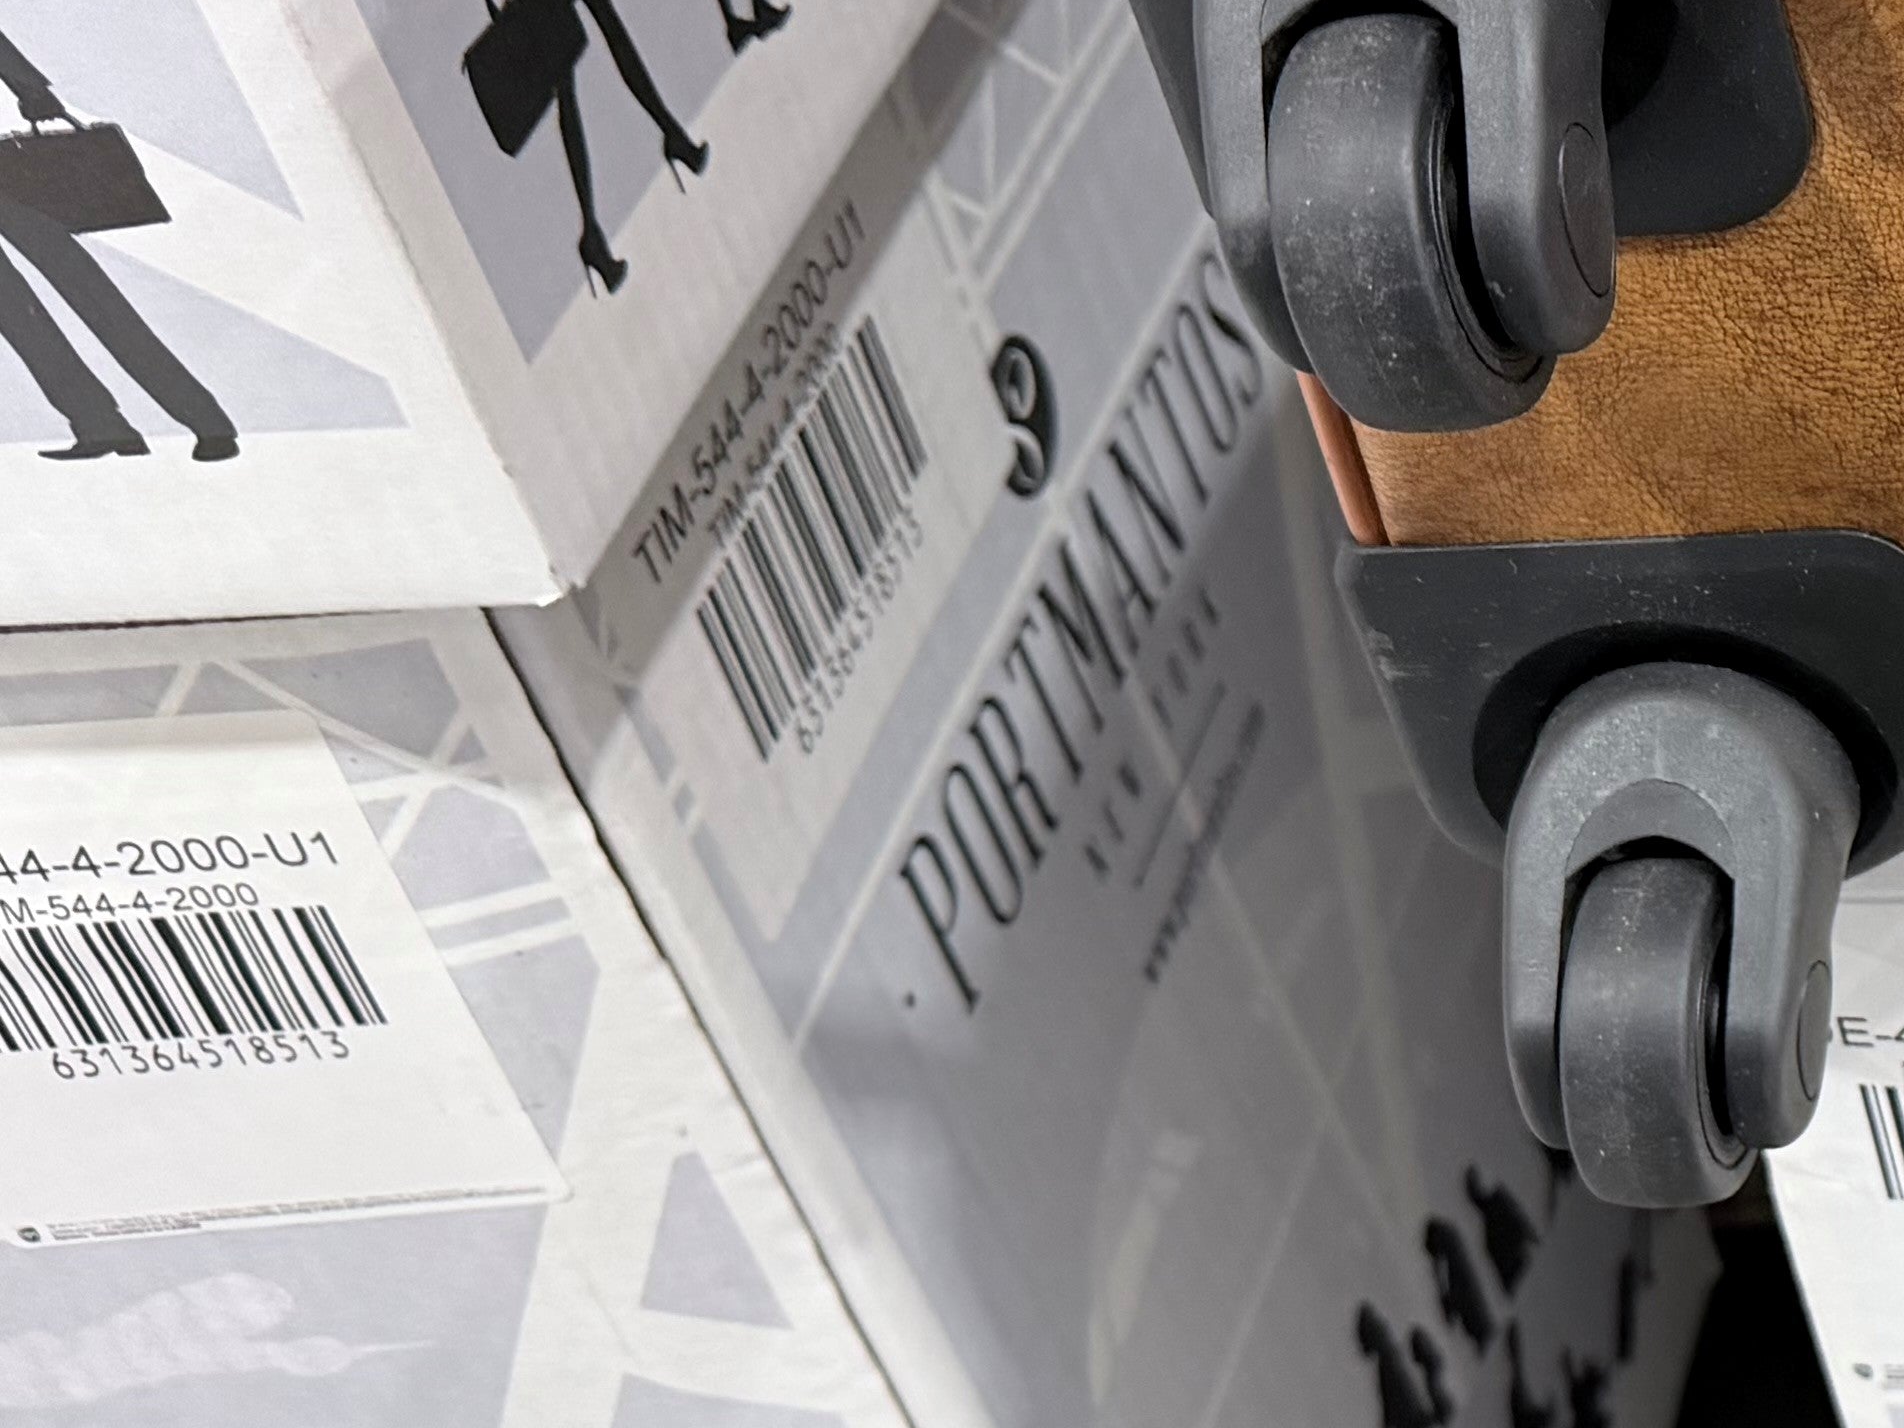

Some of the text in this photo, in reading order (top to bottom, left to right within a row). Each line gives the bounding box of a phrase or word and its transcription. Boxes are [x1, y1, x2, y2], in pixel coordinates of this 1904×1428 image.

[632, 198, 866, 584] TIM-544-4-2000-U1
[900, 252, 1264, 1016] PORTMANTOS
[0, 882, 259, 924] M-544-4-2000
[53, 1030, 350, 1081] 631364518513
